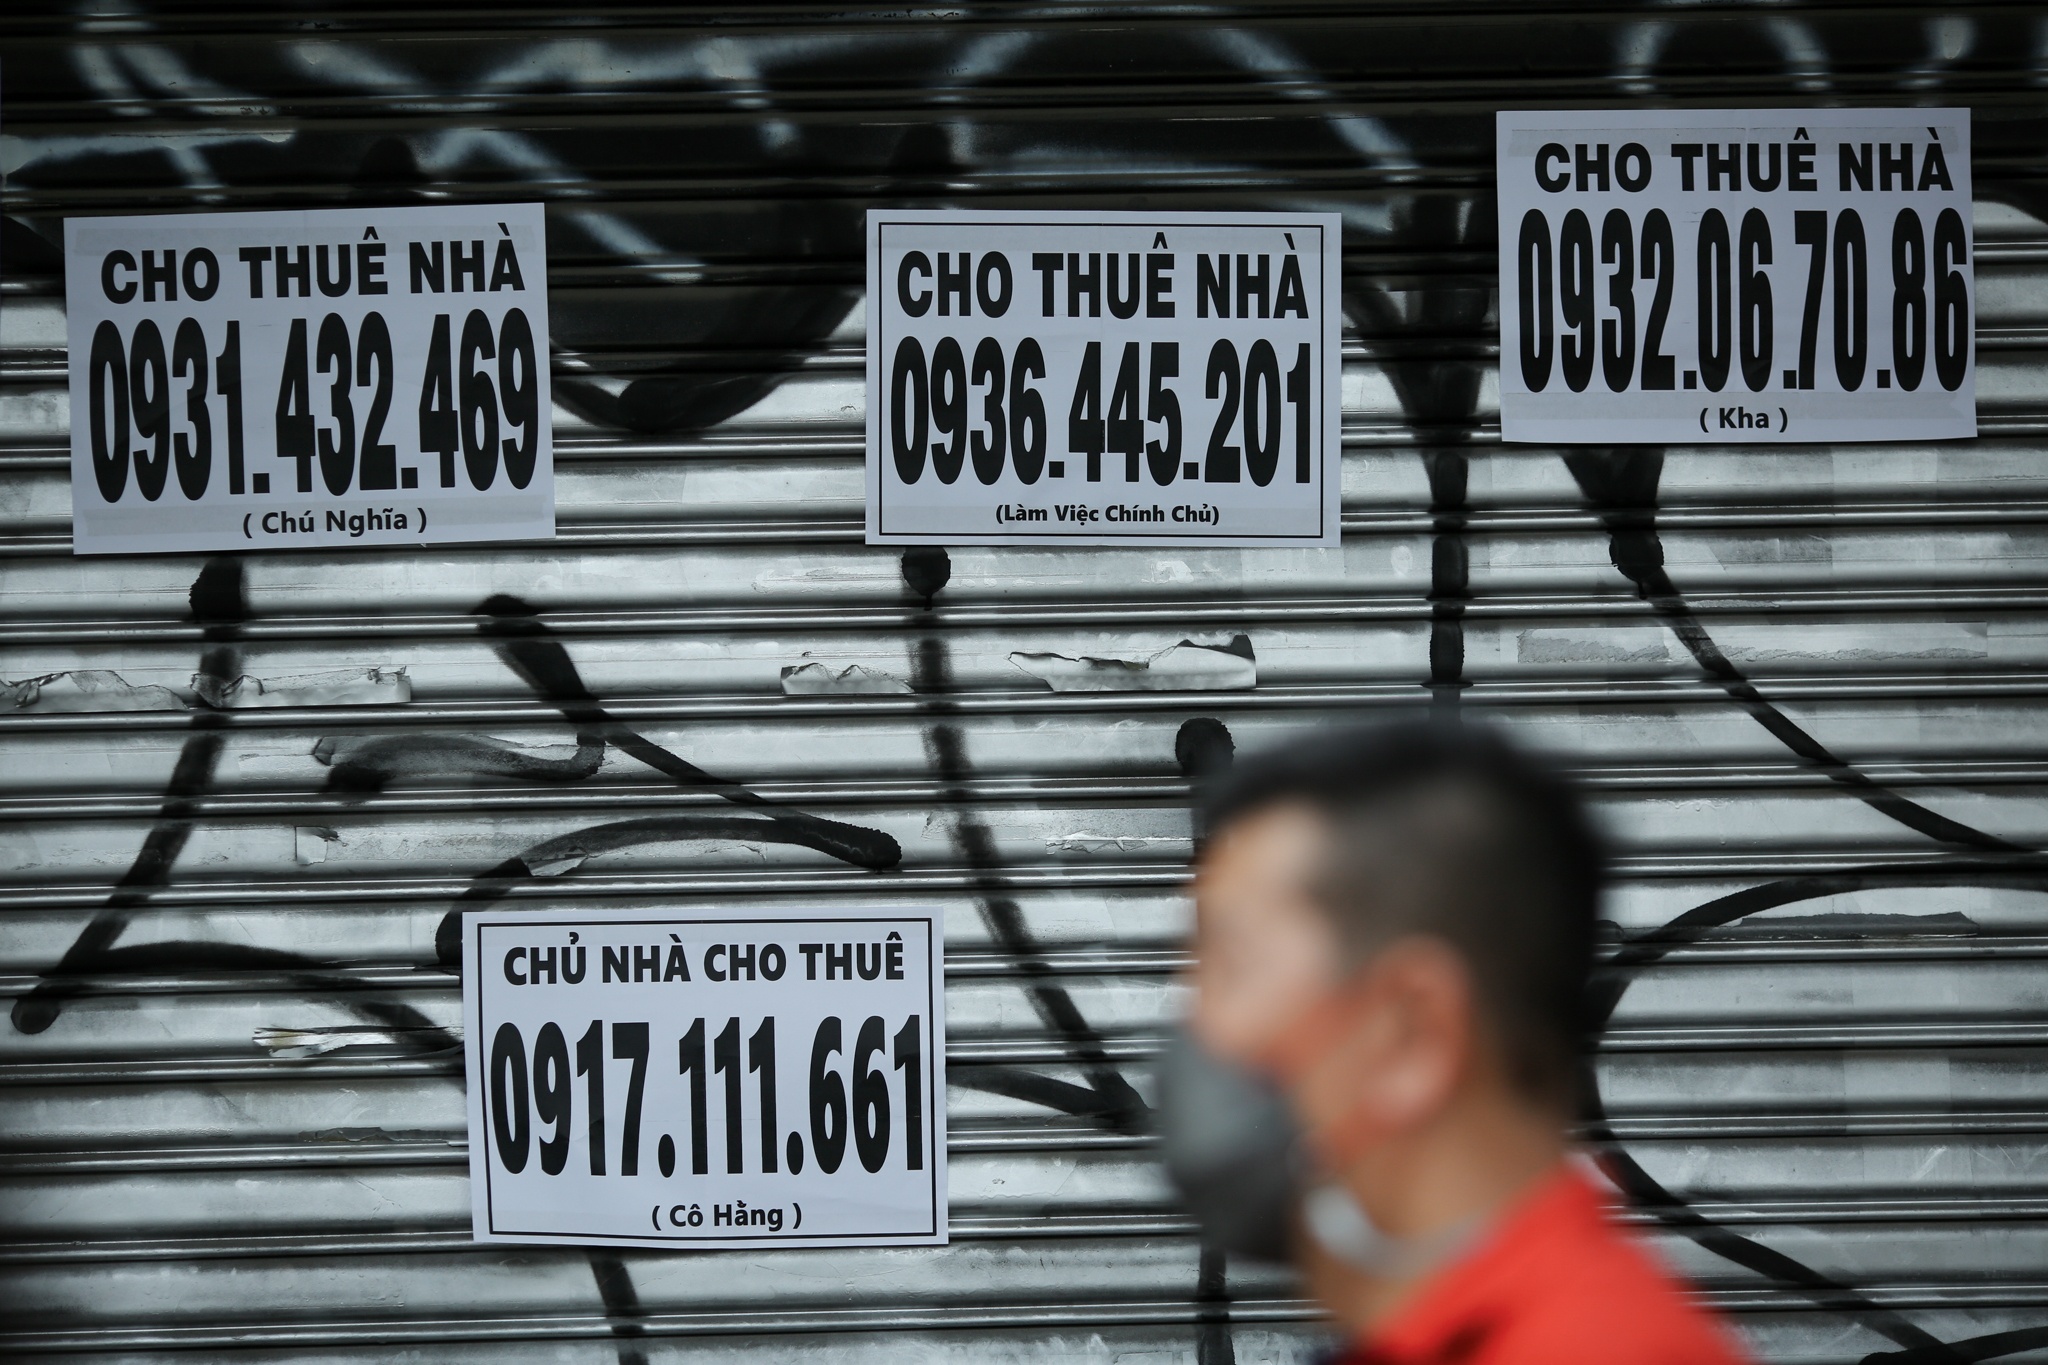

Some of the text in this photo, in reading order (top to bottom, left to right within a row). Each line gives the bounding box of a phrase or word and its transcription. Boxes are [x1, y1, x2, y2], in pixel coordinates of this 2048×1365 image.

[1534, 126, 1955, 194] CHO THUÊ NHÀ
[100, 222, 526, 305] CHO THUÊ NHÀ
[897, 231, 1310, 320] CHO THUÊ NHÀ
[1517, 206, 1969, 394] 0932.06.70.86
[88, 308, 539, 504] 0931.432.469
[890, 335, 1311, 488] 0936.445.201
[1719, 406, 1770, 429] Kha
[261, 508, 316, 534] Chú
[325, 507, 408, 538] Nghĩa
[995, 503, 1220, 526] (Làm Việc Chính Chủ)
[503, 931, 904, 986] CHỦ NHÀ CHO THUÊ
[490, 1014, 923, 1179] 0917.111.661
[669, 1203, 704, 1228] Cô
[713, 1199, 783, 1232] Hằng
